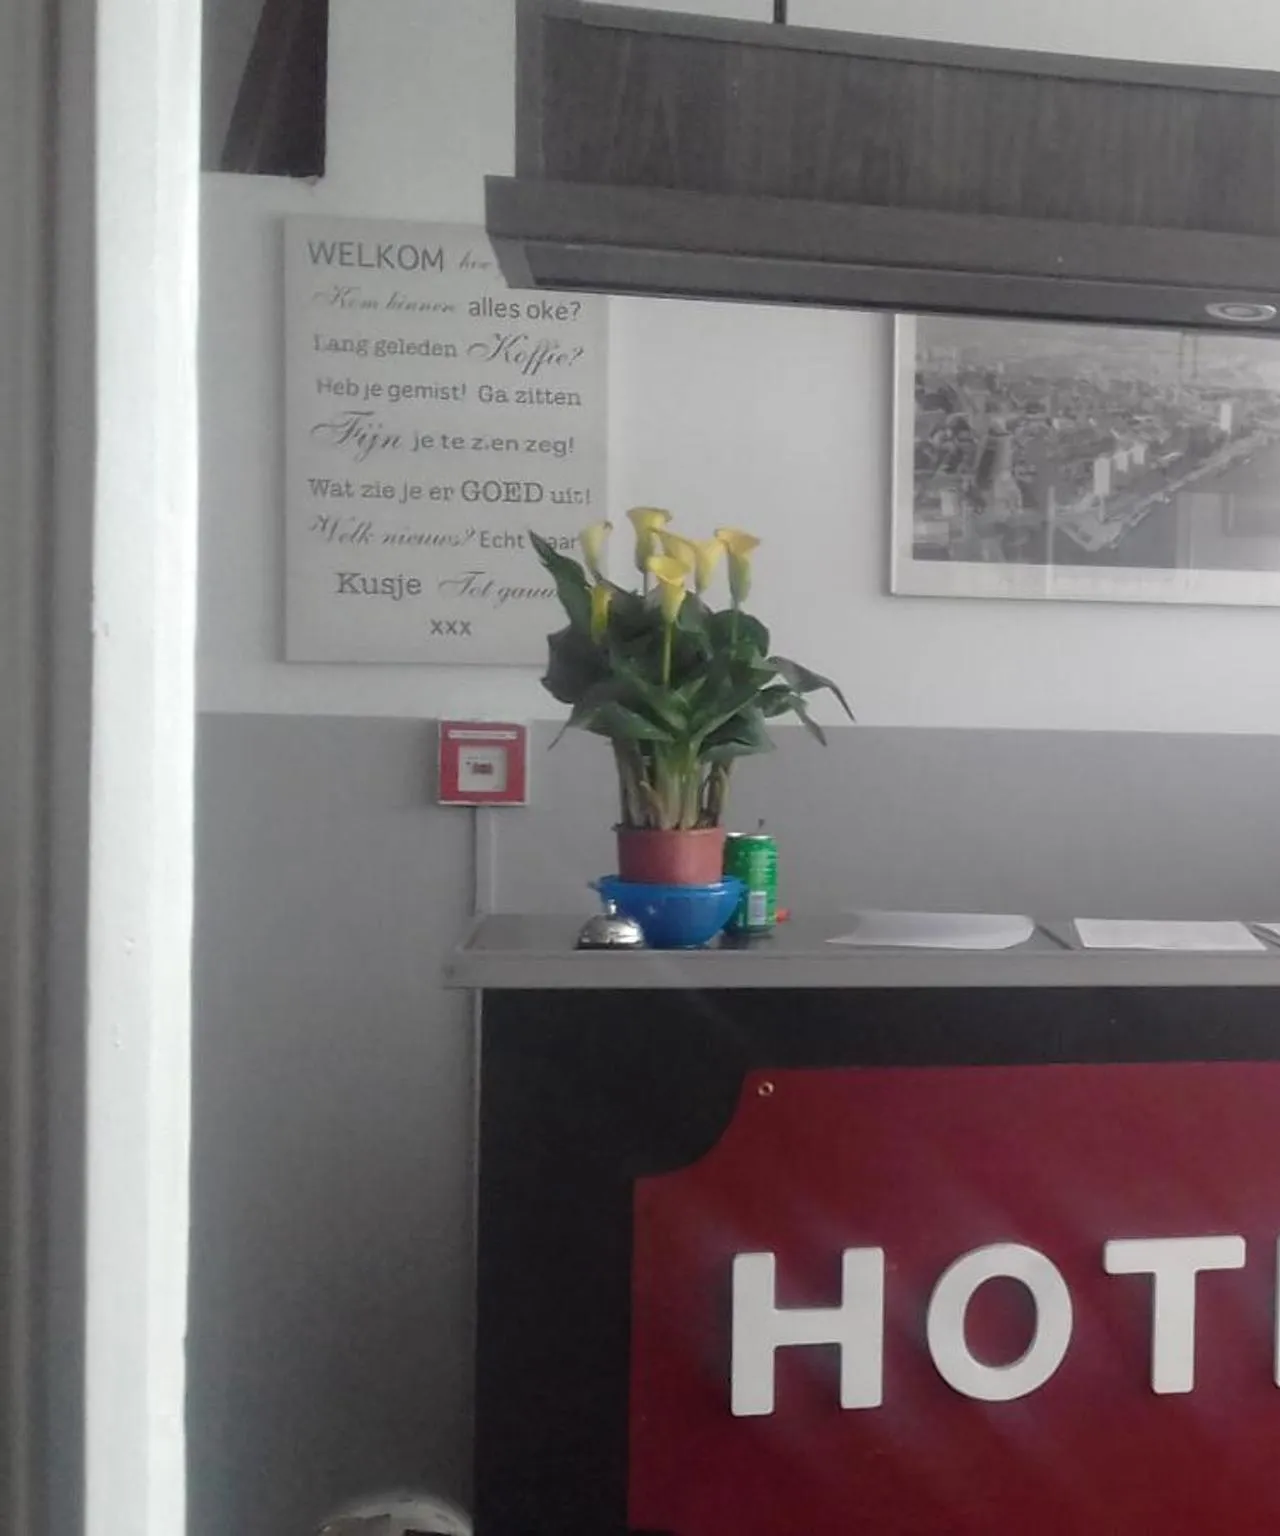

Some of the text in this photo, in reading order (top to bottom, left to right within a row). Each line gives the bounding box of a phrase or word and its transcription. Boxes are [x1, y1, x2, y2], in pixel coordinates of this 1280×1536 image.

[308, 241, 444, 272] WELKOM
[468, 297, 521, 318] alles
[526, 301, 581, 321] oke?
[314, 333, 584, 376] Lang geleden Koffie?
[316, 378, 582, 407] Heb je gemist! Ga zitten
[413, 430, 435, 452] je
[441, 434, 465, 450] te
[525, 436, 575, 458] zeg!
[308, 478, 353, 496] Wat
[361, 481, 395, 499] zie
[399, 478, 423, 503] je
[429, 484, 454, 501] er
[461, 480, 545, 503] GOED
[480, 530, 525, 549] Echt
[335, 572, 423, 601] Kusje
[430, 619, 472, 637] xxx
